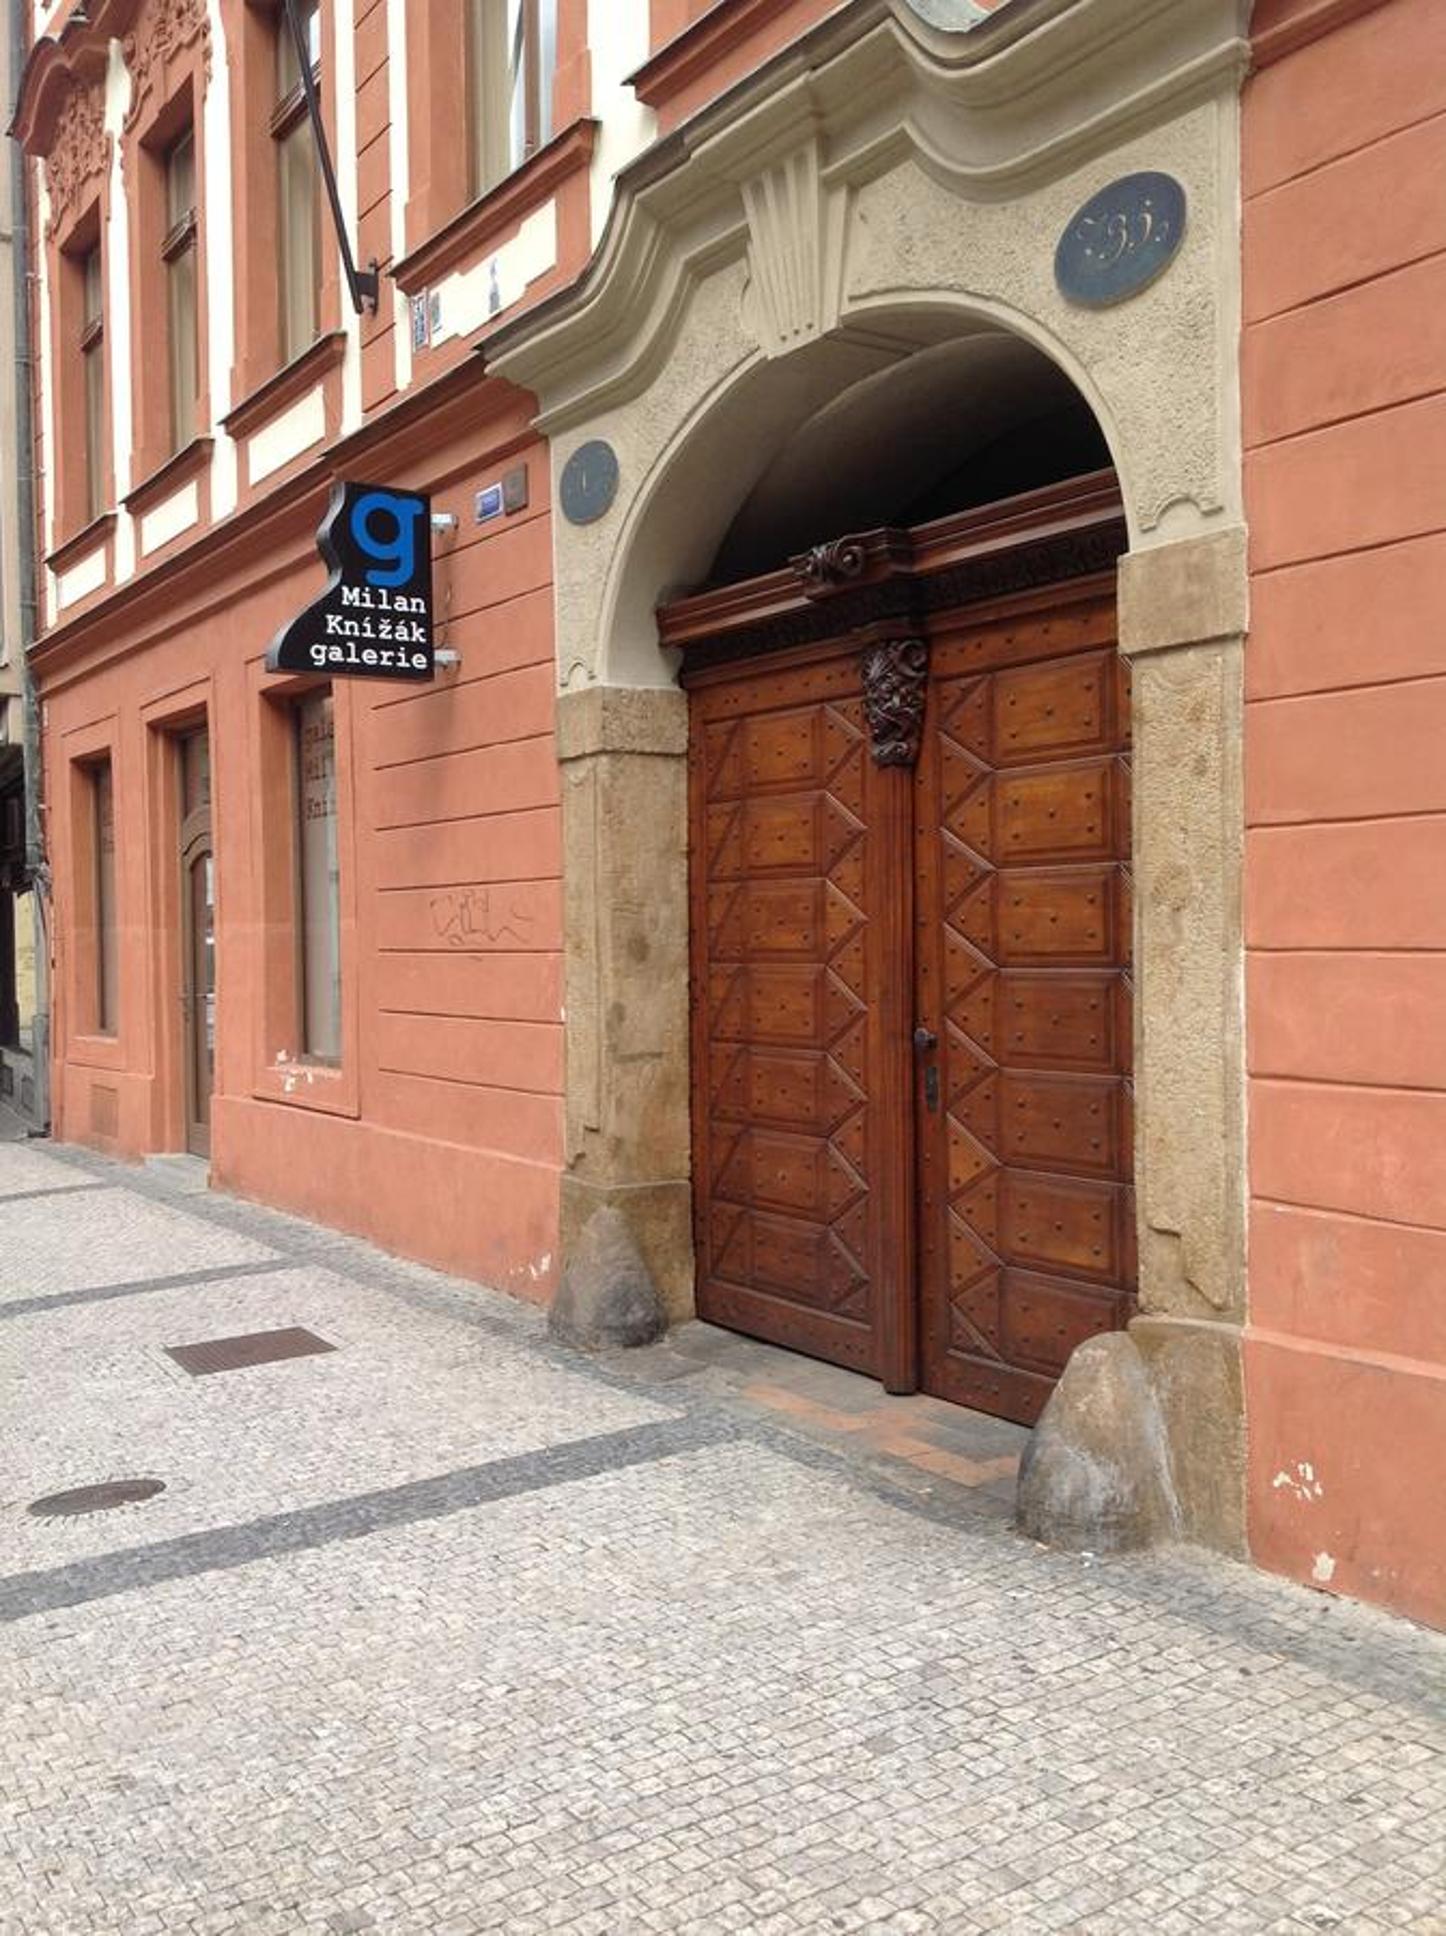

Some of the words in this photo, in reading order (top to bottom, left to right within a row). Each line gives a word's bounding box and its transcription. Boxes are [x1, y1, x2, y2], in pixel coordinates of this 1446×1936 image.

[352, 491, 425, 587] g
[340, 586, 427, 614] Milan
[325, 614, 427, 643] Knížák
[310, 643, 428, 669] galerie
